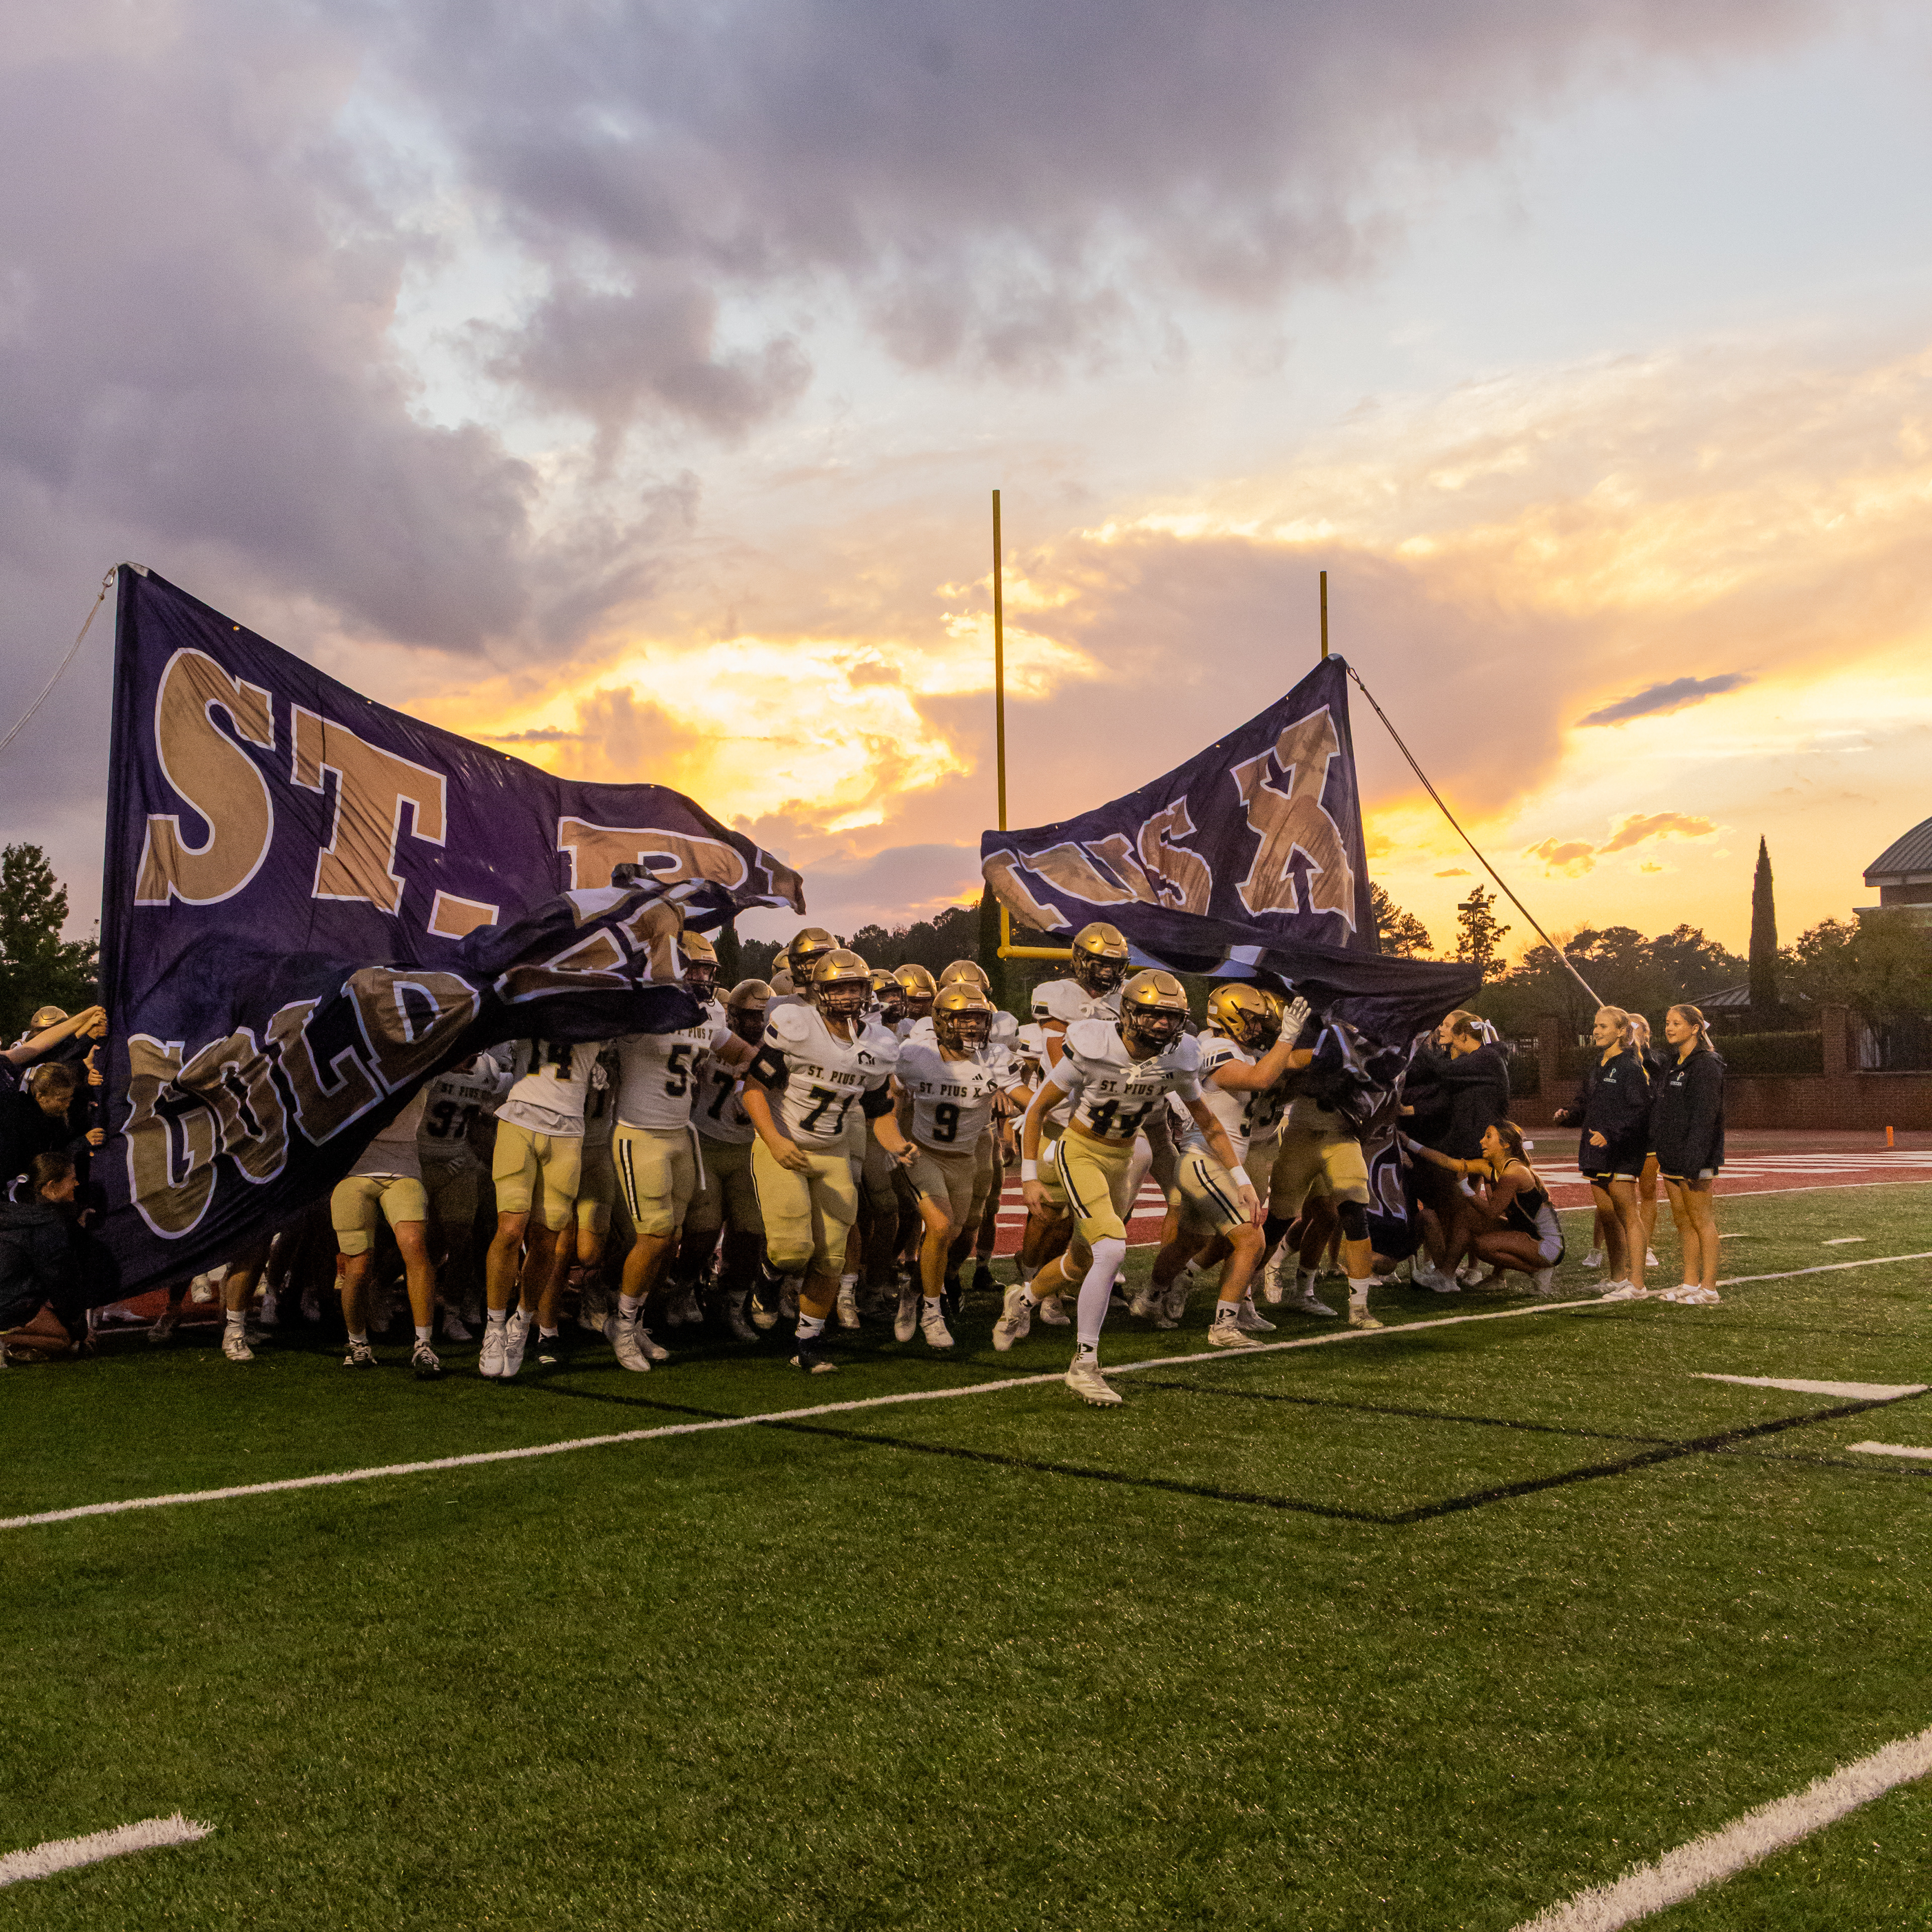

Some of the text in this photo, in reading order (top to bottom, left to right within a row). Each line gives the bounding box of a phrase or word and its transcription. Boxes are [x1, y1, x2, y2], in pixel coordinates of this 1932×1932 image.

[134, 647, 500, 940] ST.
[1230, 703, 1356, 933] X
[688, 1027, 705, 1039] PIUS
[665, 1043, 711, 1098] 5
[807, 1065, 866, 1086] ST. PIUS X
[919, 1081, 982, 1098] ST. PIUS X
[1100, 1080, 1168, 1096] ST. PIUS X
[933, 1101, 960, 1143] 9
